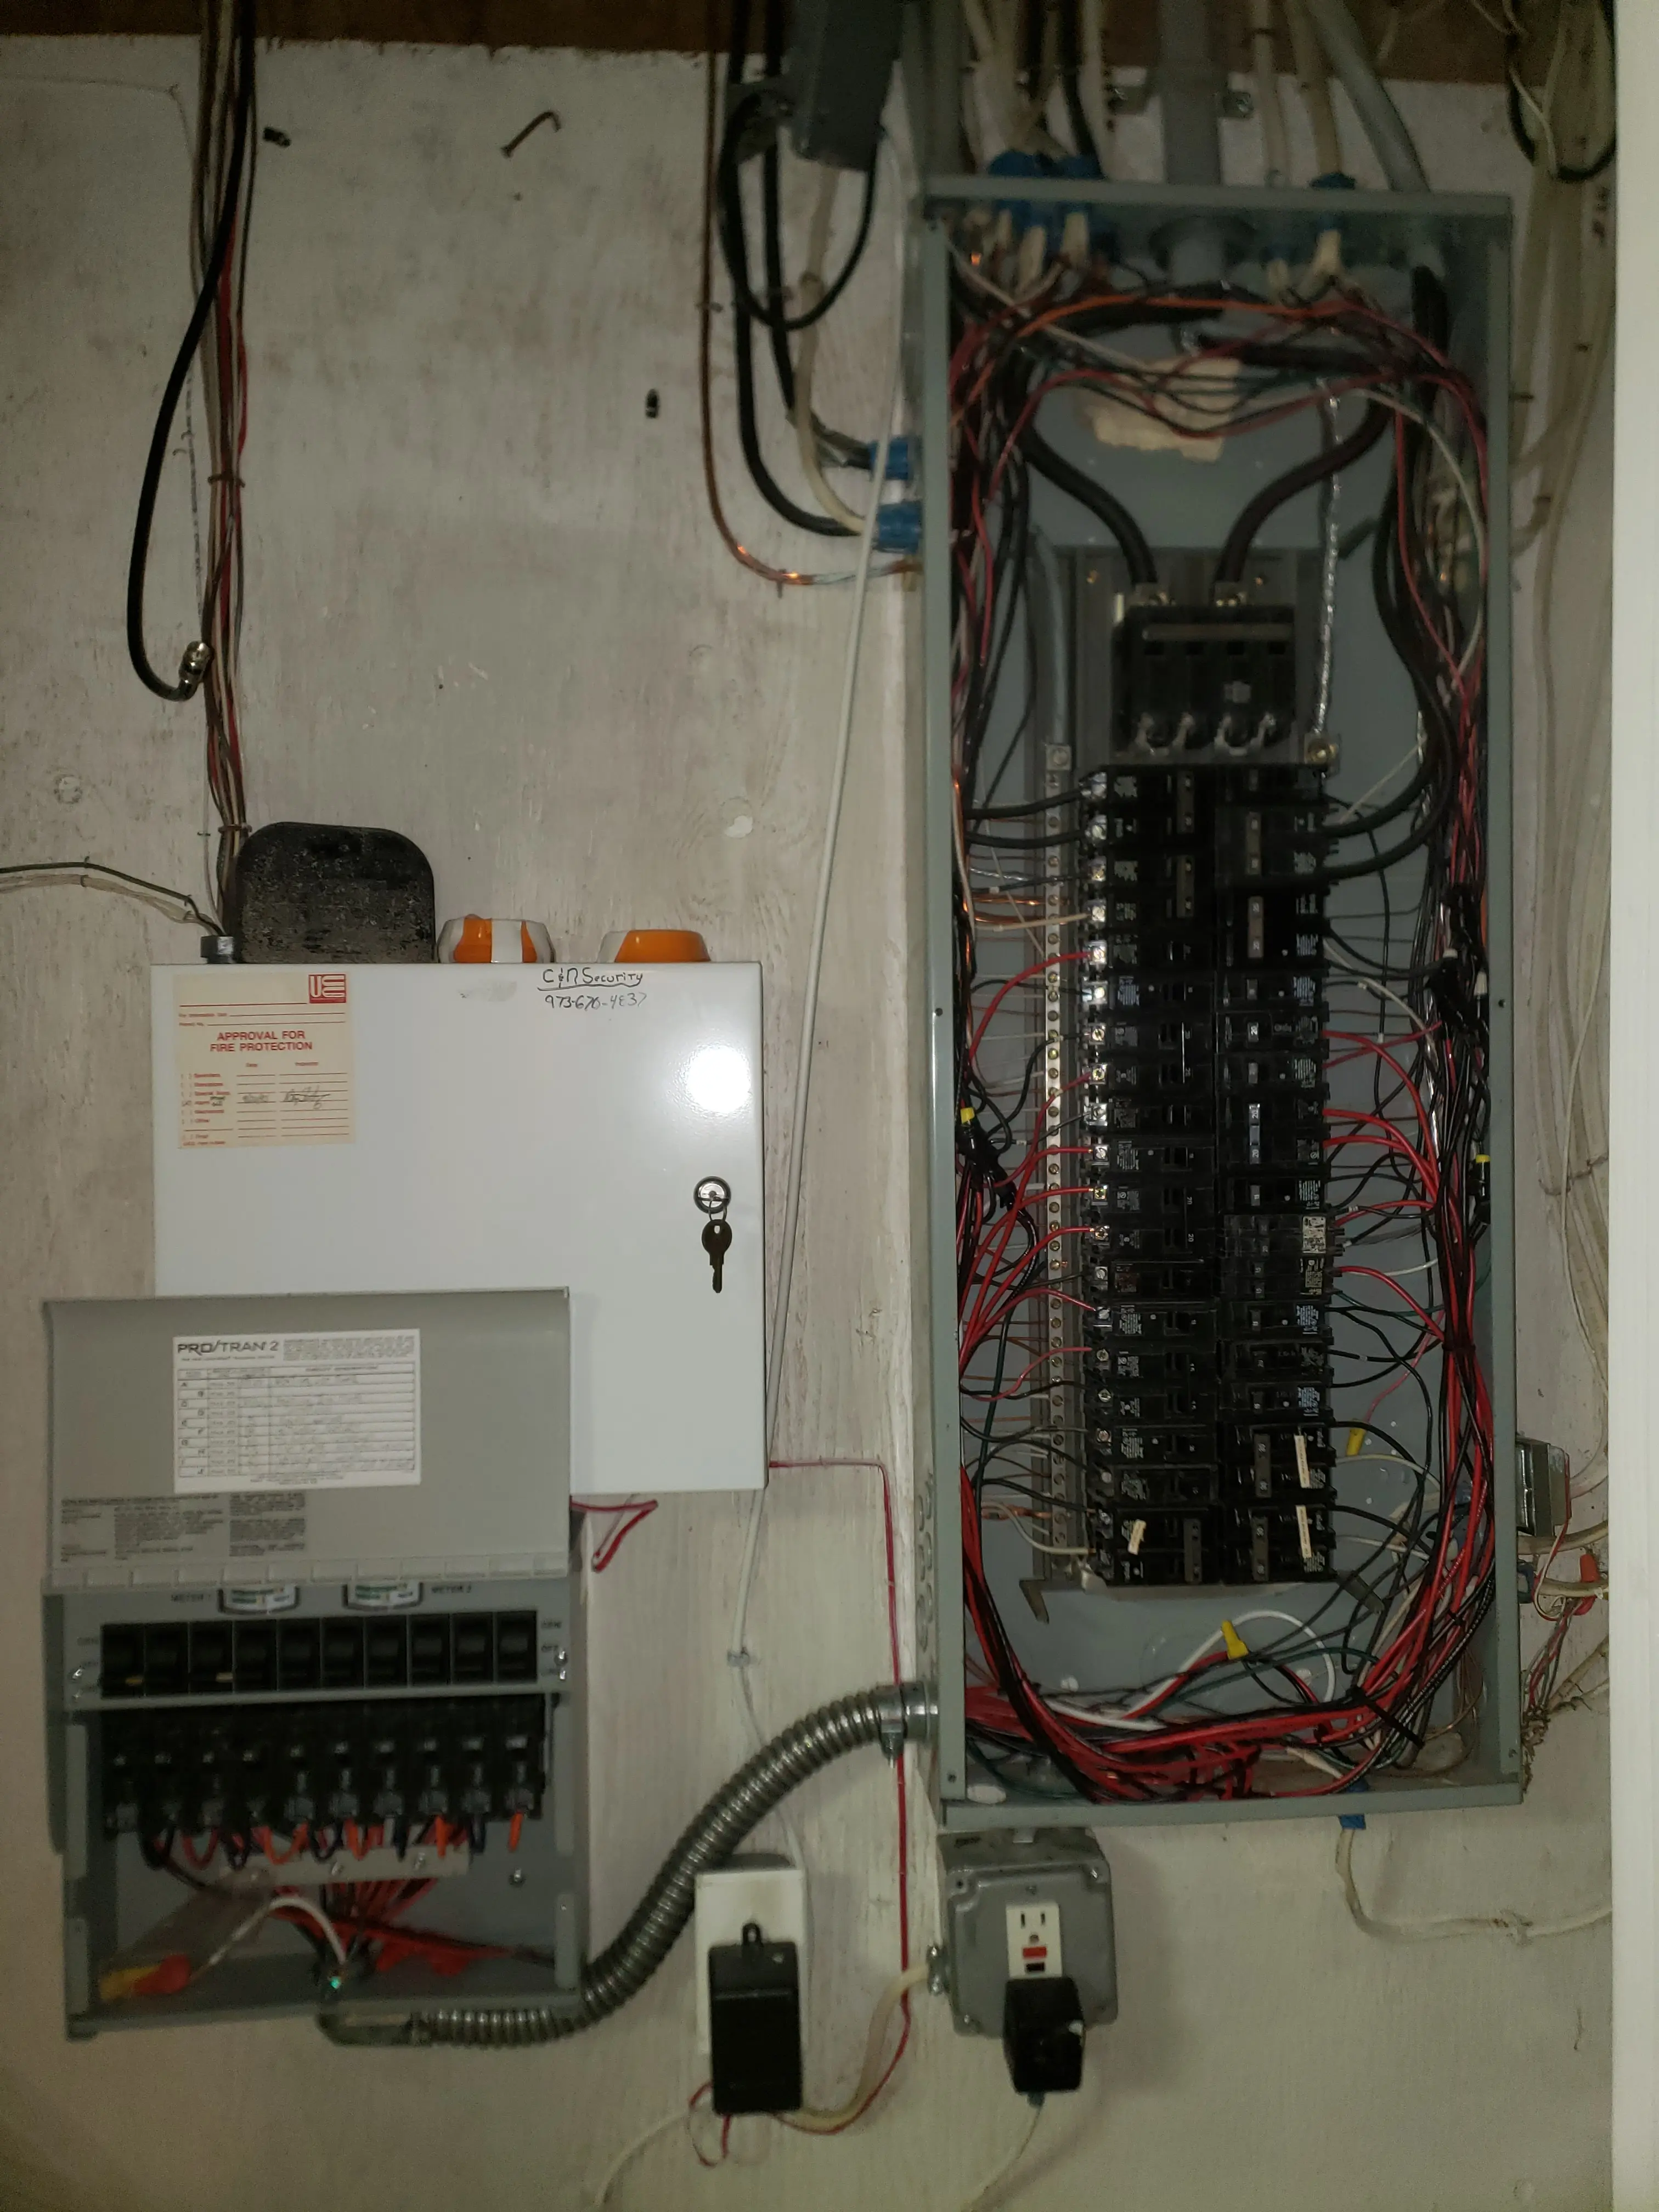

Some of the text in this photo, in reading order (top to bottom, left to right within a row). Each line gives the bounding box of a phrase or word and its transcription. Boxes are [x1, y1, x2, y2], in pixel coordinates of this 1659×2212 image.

[217, 1031, 306, 1040] APPROVAL FOR
[210, 1042, 313, 1052] FIRE PROTECTION
[270, 1341, 278, 1351] 2
